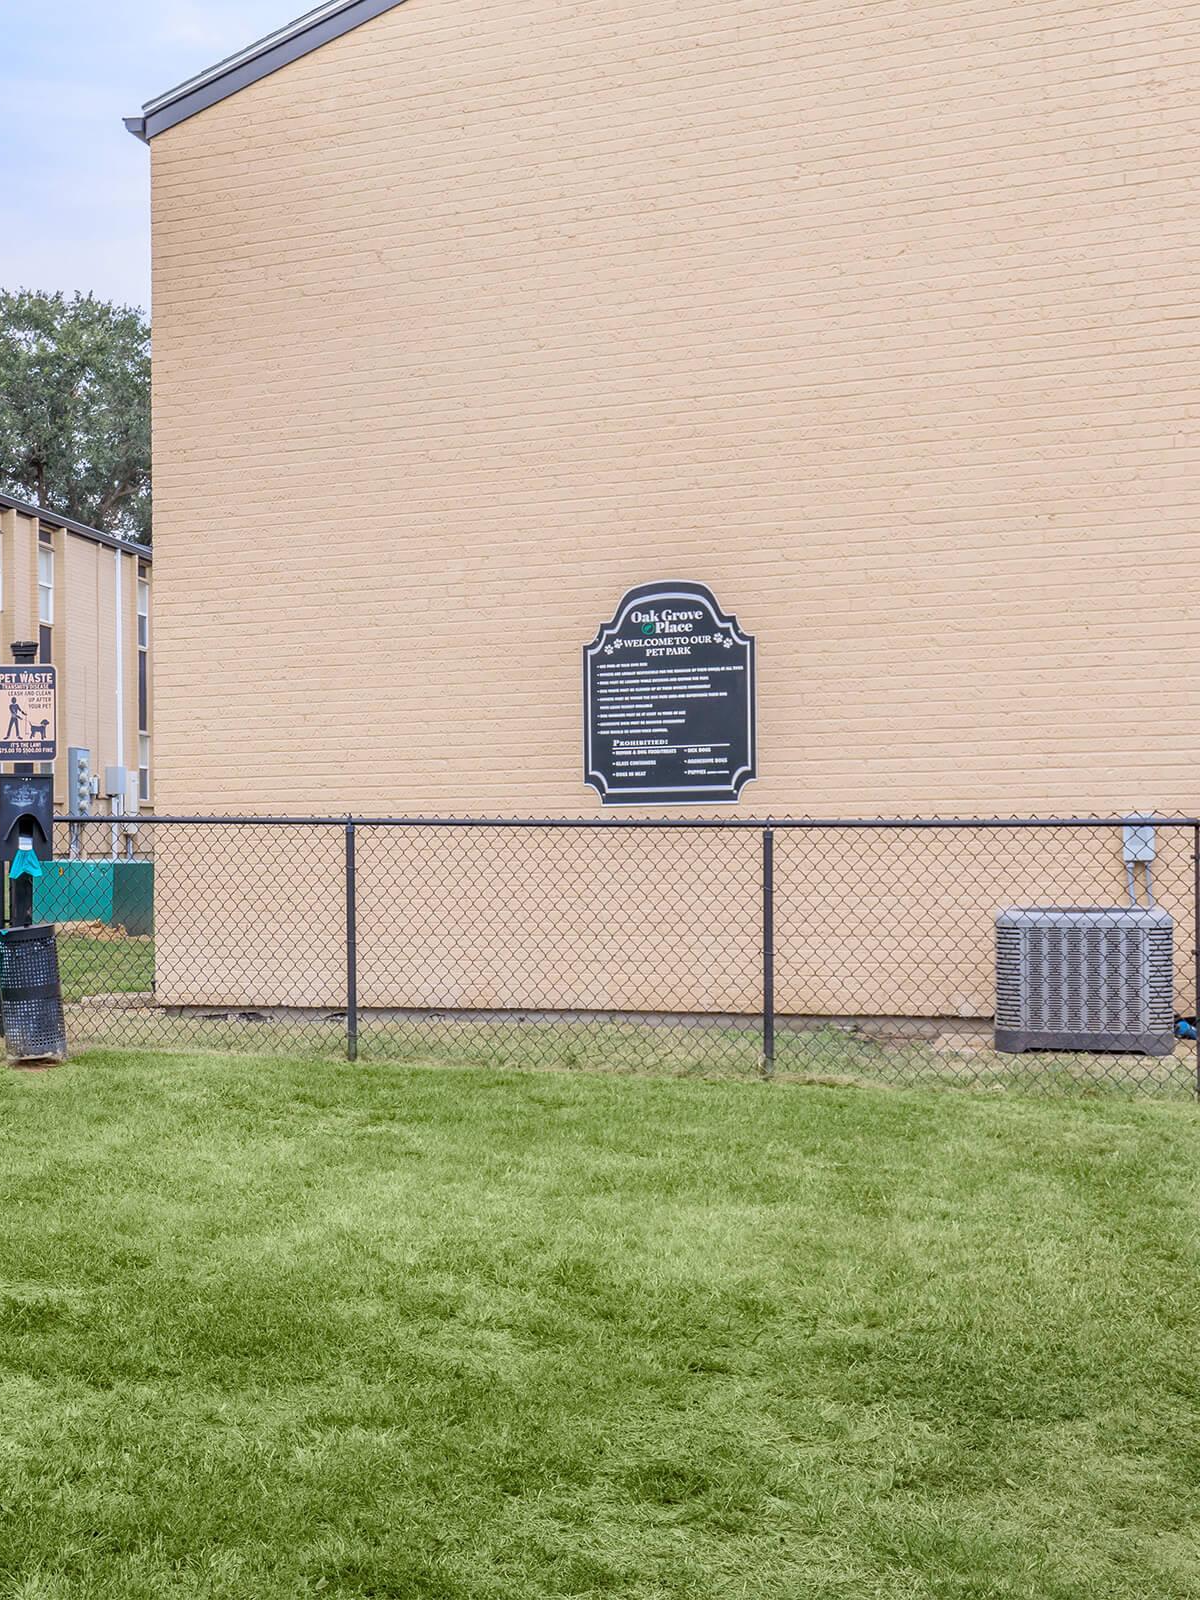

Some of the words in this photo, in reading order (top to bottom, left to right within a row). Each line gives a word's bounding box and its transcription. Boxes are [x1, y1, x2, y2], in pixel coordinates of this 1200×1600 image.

[631, 610, 660, 623] Oak
[661, 609, 703, 621] Grove
[655, 621, 693, 634] Place
[624, 637, 674, 647] WELCOME
[674, 636, 689, 645] TO
[690, 635, 712, 644] OUR
[646, 648, 665, 657] PET
[666, 646, 692, 655] PARK
[19, 673, 53, 683] WASTE
